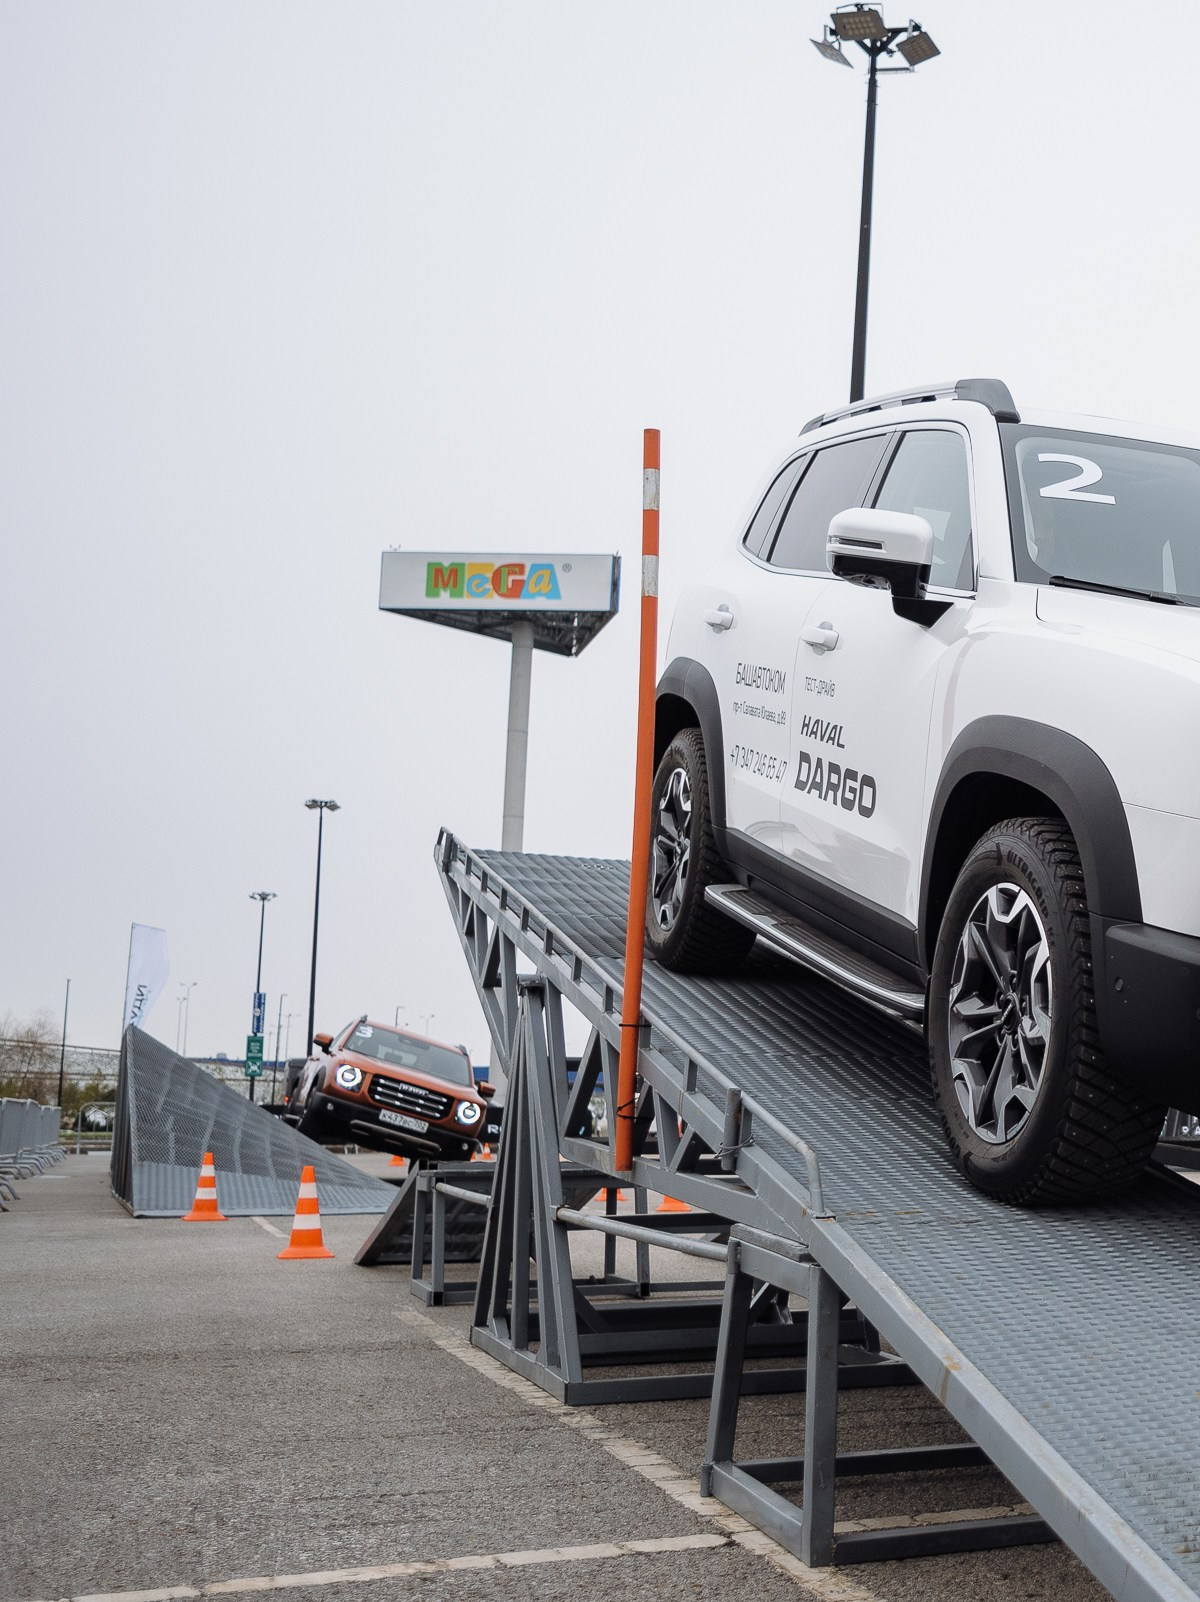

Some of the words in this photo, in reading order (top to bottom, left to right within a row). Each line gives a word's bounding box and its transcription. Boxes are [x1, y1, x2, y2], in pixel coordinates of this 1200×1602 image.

[1038, 453, 1116, 505] 2
[735, 662, 787, 695] БАШАВТОКОМ
[804, 676, 836, 698] ТЕСТ-ДРАЙВ
[800, 714, 846, 749] HAVAL
[740, 746, 754, 771] 347
[753, 751, 768, 776] 246
[776, 759, 788, 783] 47
[794, 750, 877, 819] DARGO
[1006, 850, 1049, 919] ULTRAGRIP
[355, 1025, 374, 1039] 3
